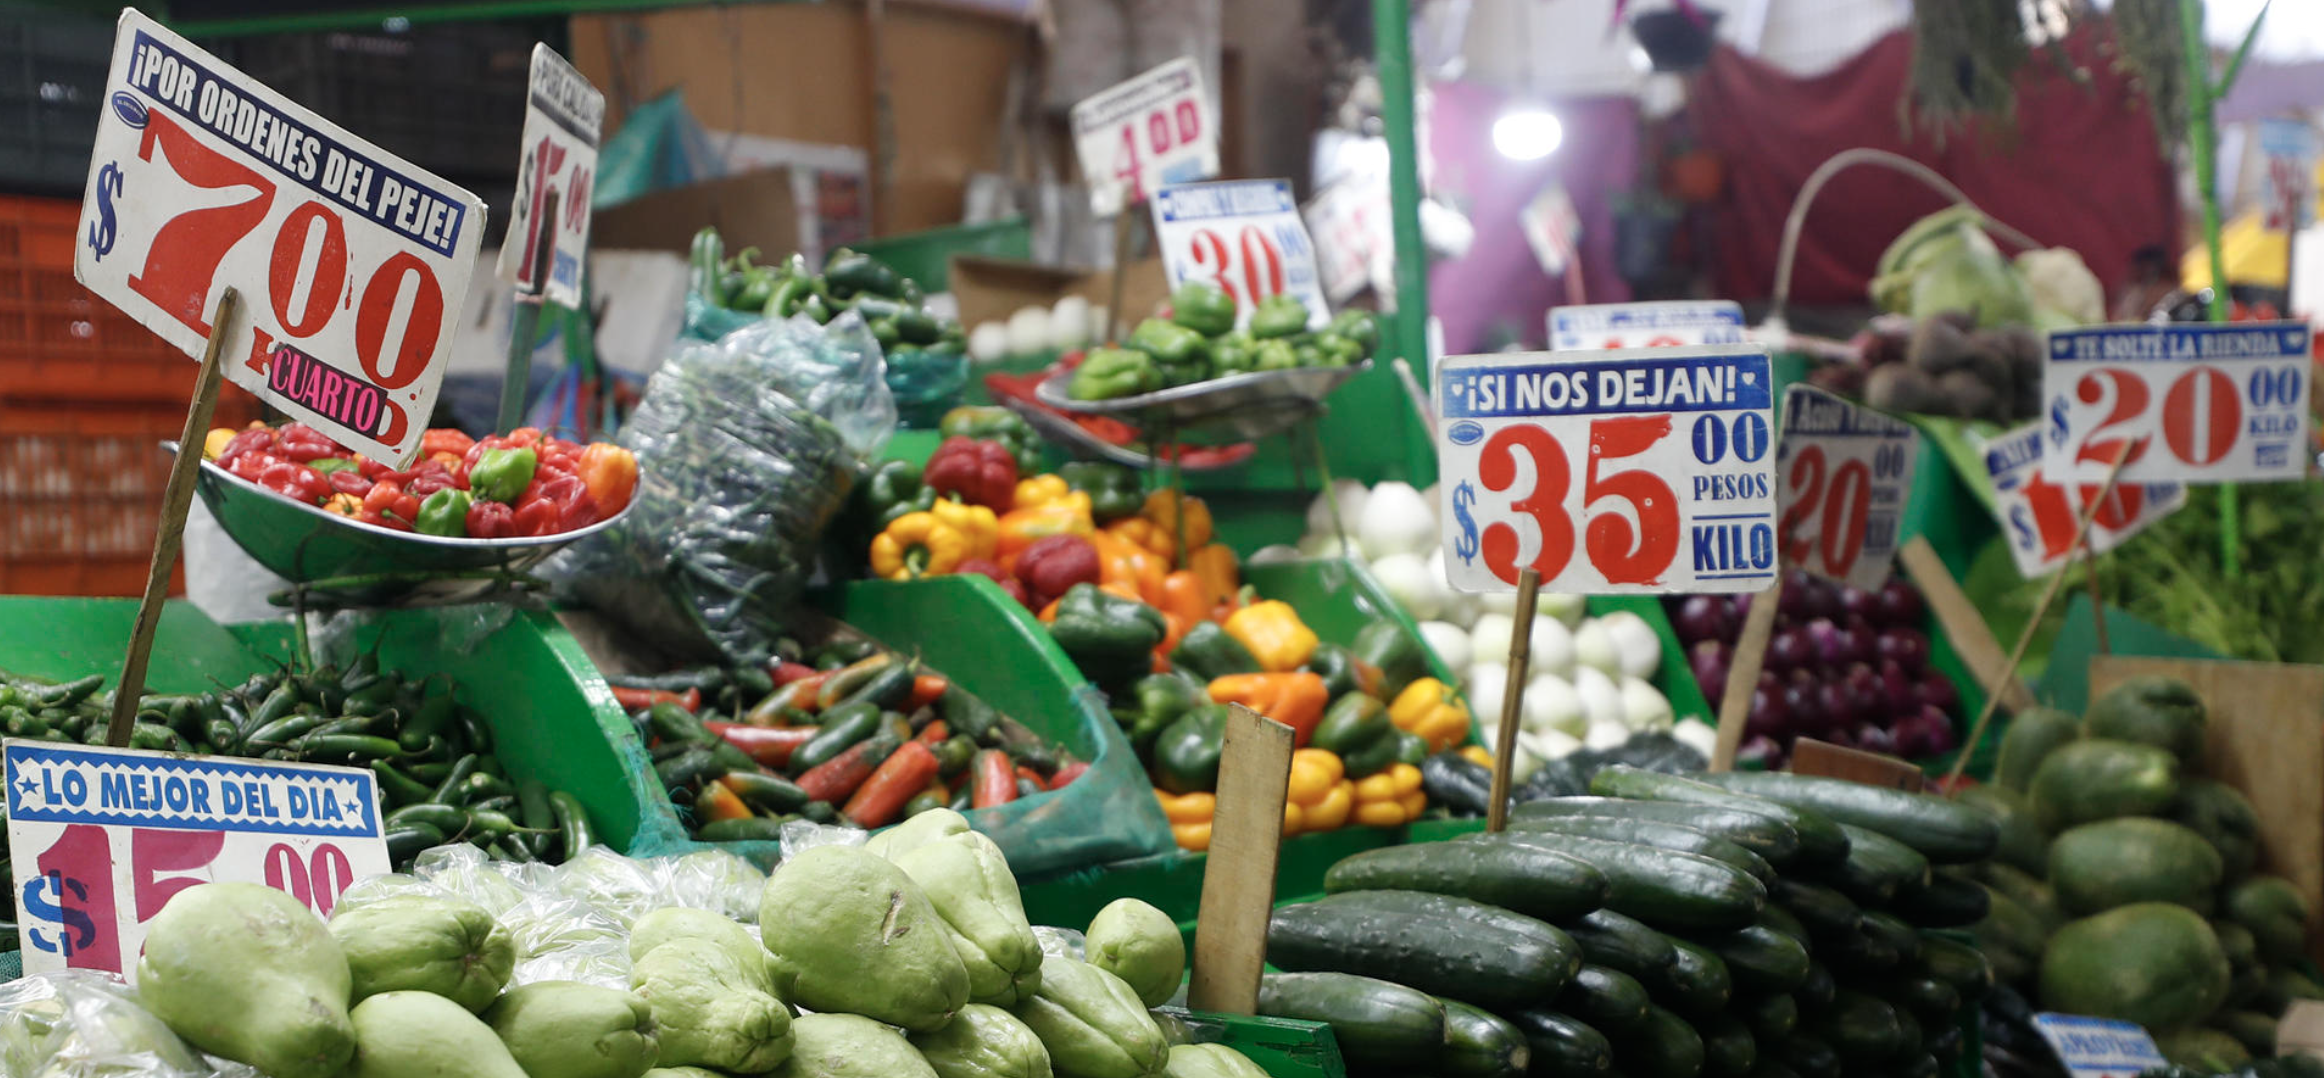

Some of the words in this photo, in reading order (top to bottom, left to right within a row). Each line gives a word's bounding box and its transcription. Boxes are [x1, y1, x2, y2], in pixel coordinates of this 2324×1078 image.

[131, 44, 197, 112] ¡POR
[198, 79, 321, 181] ORDENES
[321, 148, 374, 211] DEL
[375, 176, 459, 249] PEJE!
[89, 160, 122, 262] $
[2074, 335, 2098, 360] TE
[2170, 333, 2197, 357] LA
[2200, 331, 2281, 356] RIENDA
[272, 349, 379, 432] CUARTO
[1468, 375, 1506, 411] ¡SI
[1516, 371, 1588, 410] NOS
[1598, 365, 1736, 407] DEJAN!
[2074, 365, 2243, 468] 20
[2248, 366, 2301, 407] 00
[2248, 413, 2298, 435] KILO
[1453, 479, 1479, 567] $
[1478, 413, 1681, 588] 35
[1691, 411, 1769, 465] 00
[1692, 472, 1768, 501] PESOS
[1778, 443, 1872, 579] 20
[1691, 522, 1774, 572] KILO
[42, 767, 88, 807] LO
[100, 771, 213, 814] MEJOR
[221, 780, 279, 819] DEL
[287, 784, 344, 822] DIA
